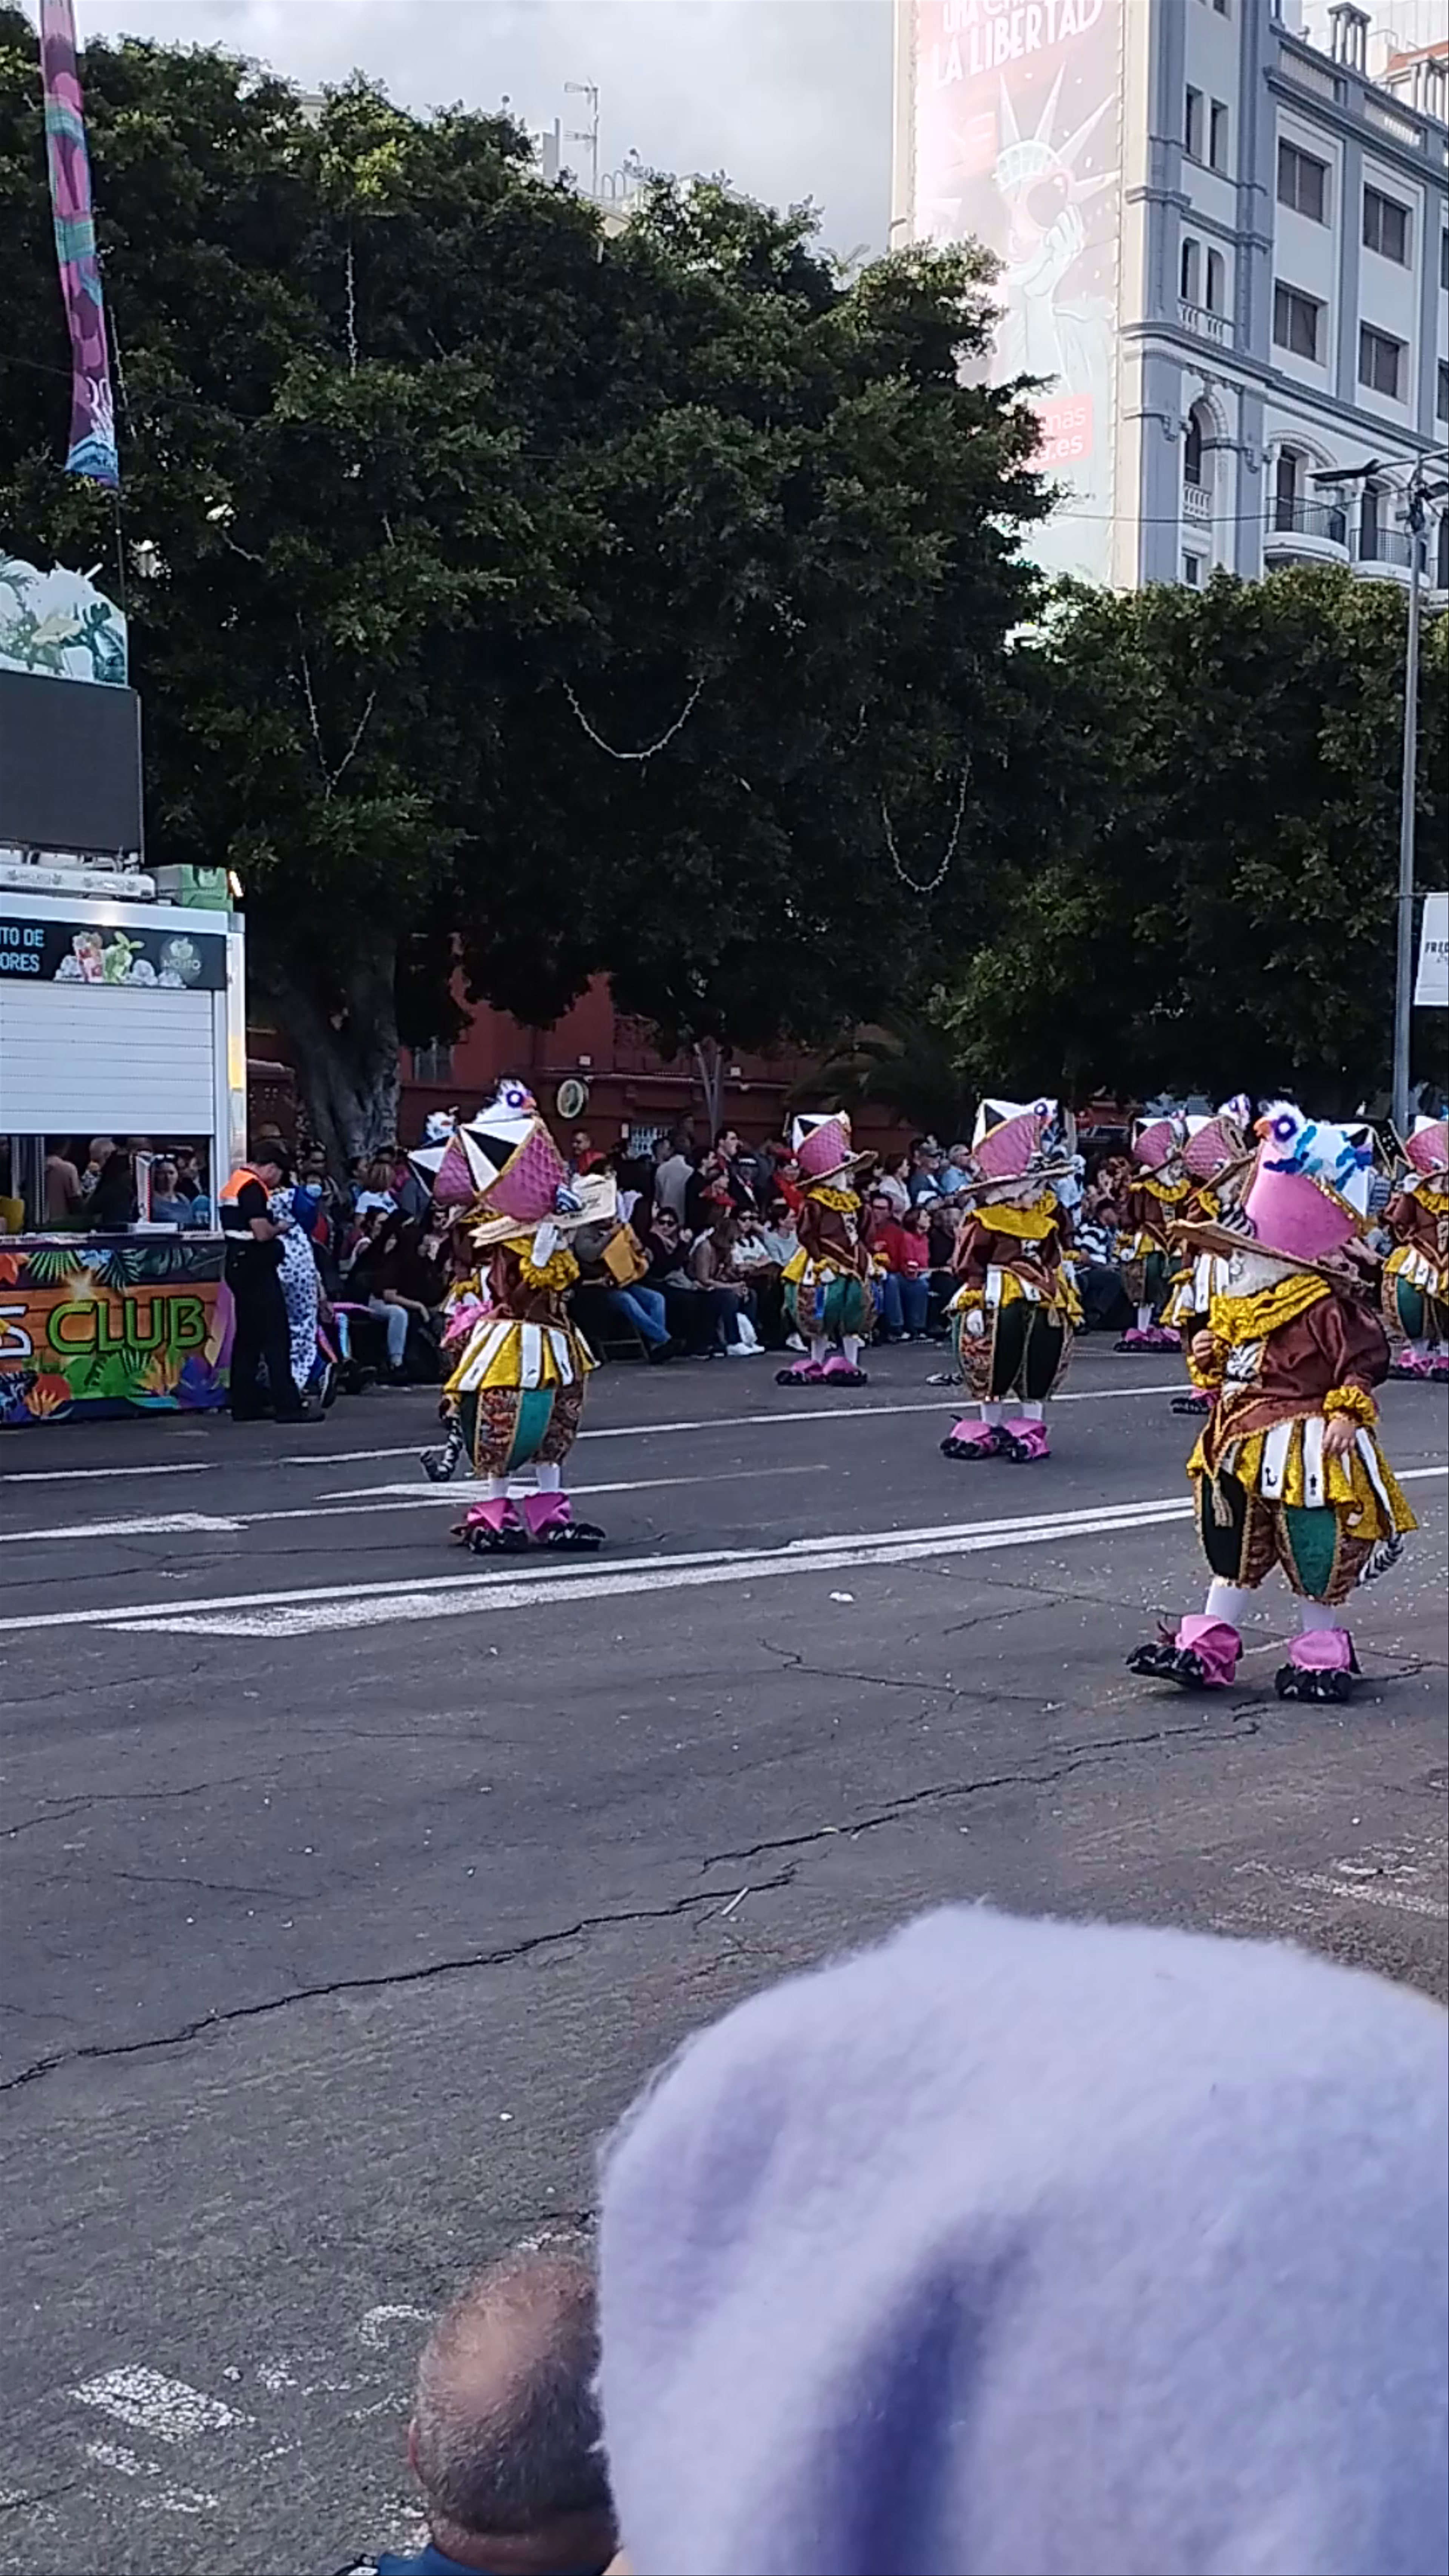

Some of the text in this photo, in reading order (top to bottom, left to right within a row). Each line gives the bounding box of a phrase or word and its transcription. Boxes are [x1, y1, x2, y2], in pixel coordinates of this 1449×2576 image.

[944, 0, 979, 34] UNA
[933, 0, 1103, 89] LA LIBERTAD
[0, 927, 44, 947] TO DE
[0, 952, 40, 972] ORES
[47, 1296, 206, 1354] CLUB
